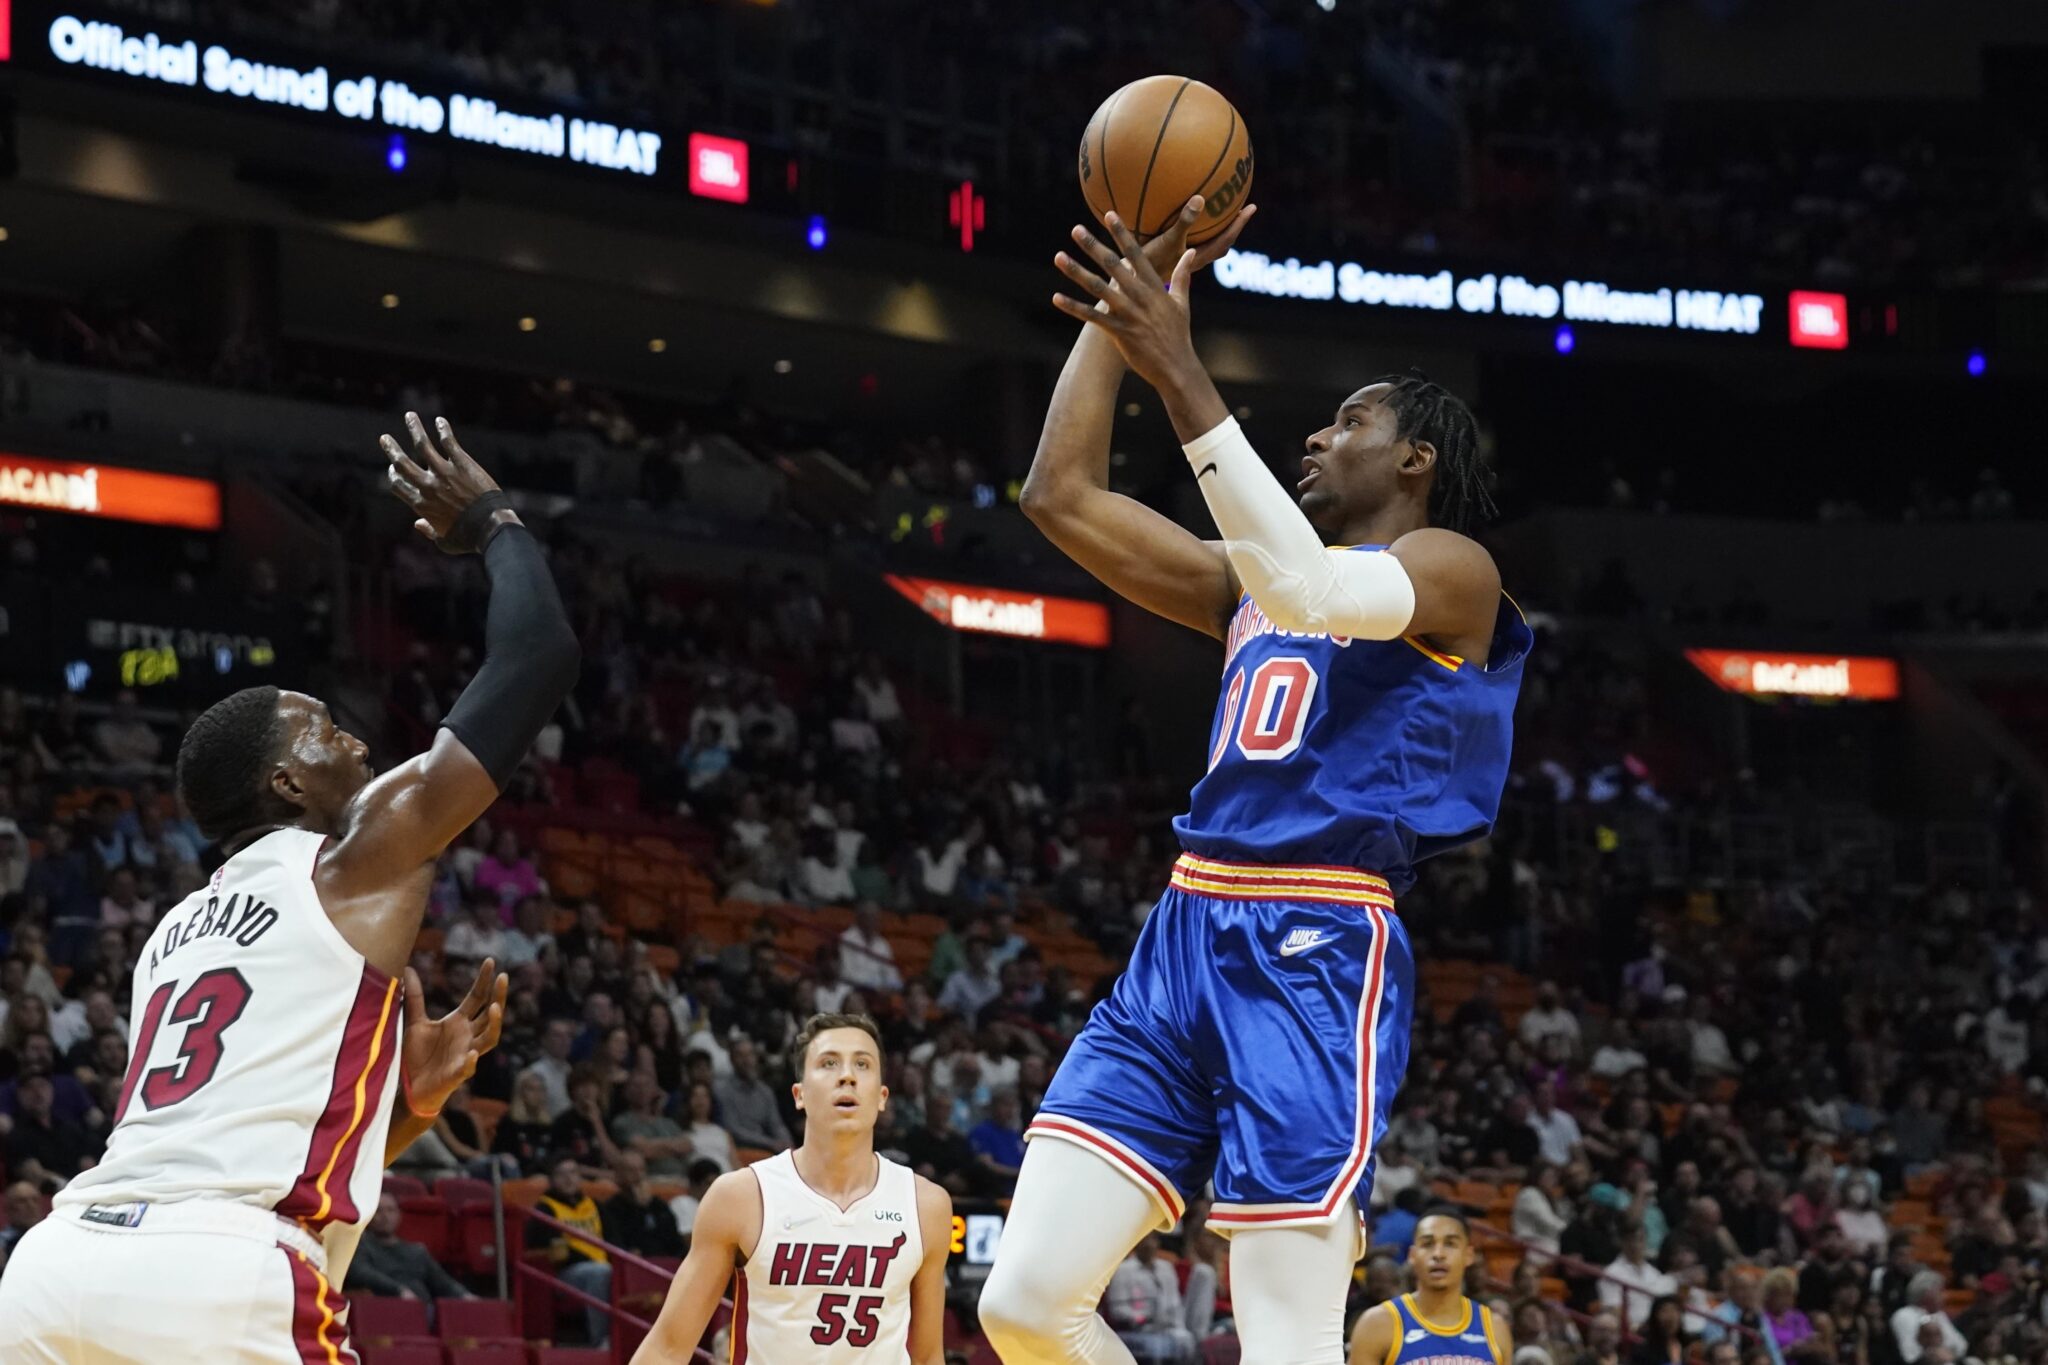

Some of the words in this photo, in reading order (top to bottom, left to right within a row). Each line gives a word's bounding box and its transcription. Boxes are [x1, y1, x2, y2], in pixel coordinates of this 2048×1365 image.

[49, 15, 197, 86] Official
[203, 45, 328, 111] Sound
[334, 76, 376, 120] of
[380, 80, 444, 133] the
[449, 94, 564, 157] Miami
[570, 118, 661, 176] HEAT
[1213, 248, 1335, 300] Official
[1338, 262, 1453, 310] Sound
[1456, 274, 1497, 313] of
[1500, 275, 1560, 319] the
[1563, 280, 1673, 327] Miami
[1675, 289, 1763, 334] HEAT
[150, 893, 279, 980] ADEBAYO
[1286, 929, 1322, 946] NIKE
[112, 966, 253, 1129] 13
[874, 1209, 903, 1222] UKG
[769, 1230, 907, 1289] HEAT
[810, 1292, 885, 1348] 55
